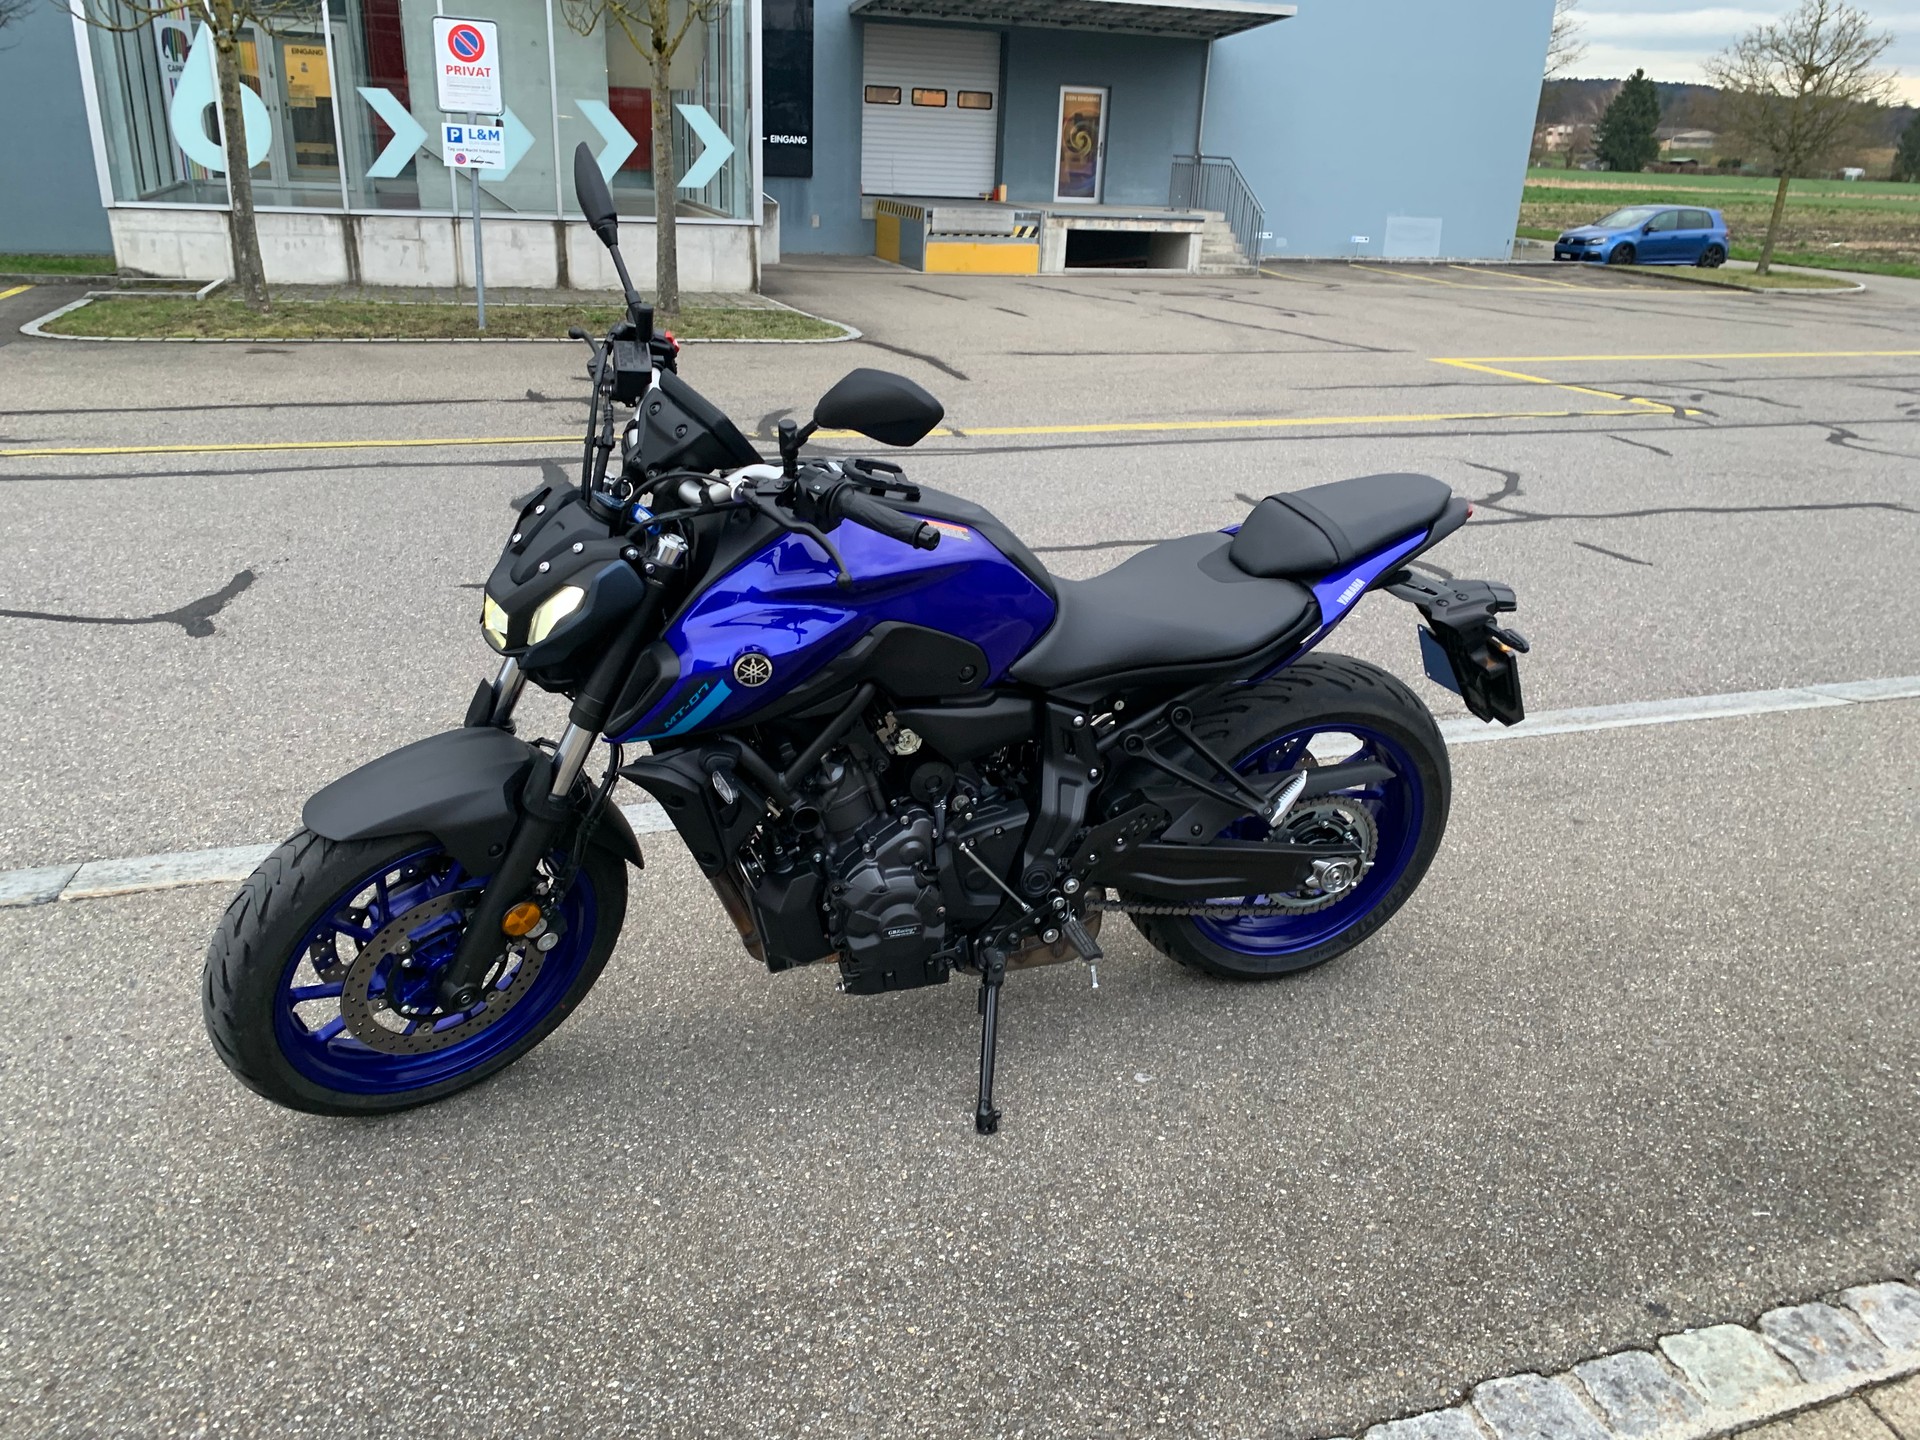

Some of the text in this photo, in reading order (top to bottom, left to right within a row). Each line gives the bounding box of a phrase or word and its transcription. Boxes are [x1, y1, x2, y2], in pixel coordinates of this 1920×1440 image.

[291, 48, 324, 56] EINGANG
[446, 65, 491, 77] PRIVAT
[450, 129, 460, 141] P
[469, 128, 500, 141] L&M
[770, 134, 807, 145] EINGANG
[1336, 577, 1366, 606] YAMAHA
[664, 681, 709, 729] MT-07
